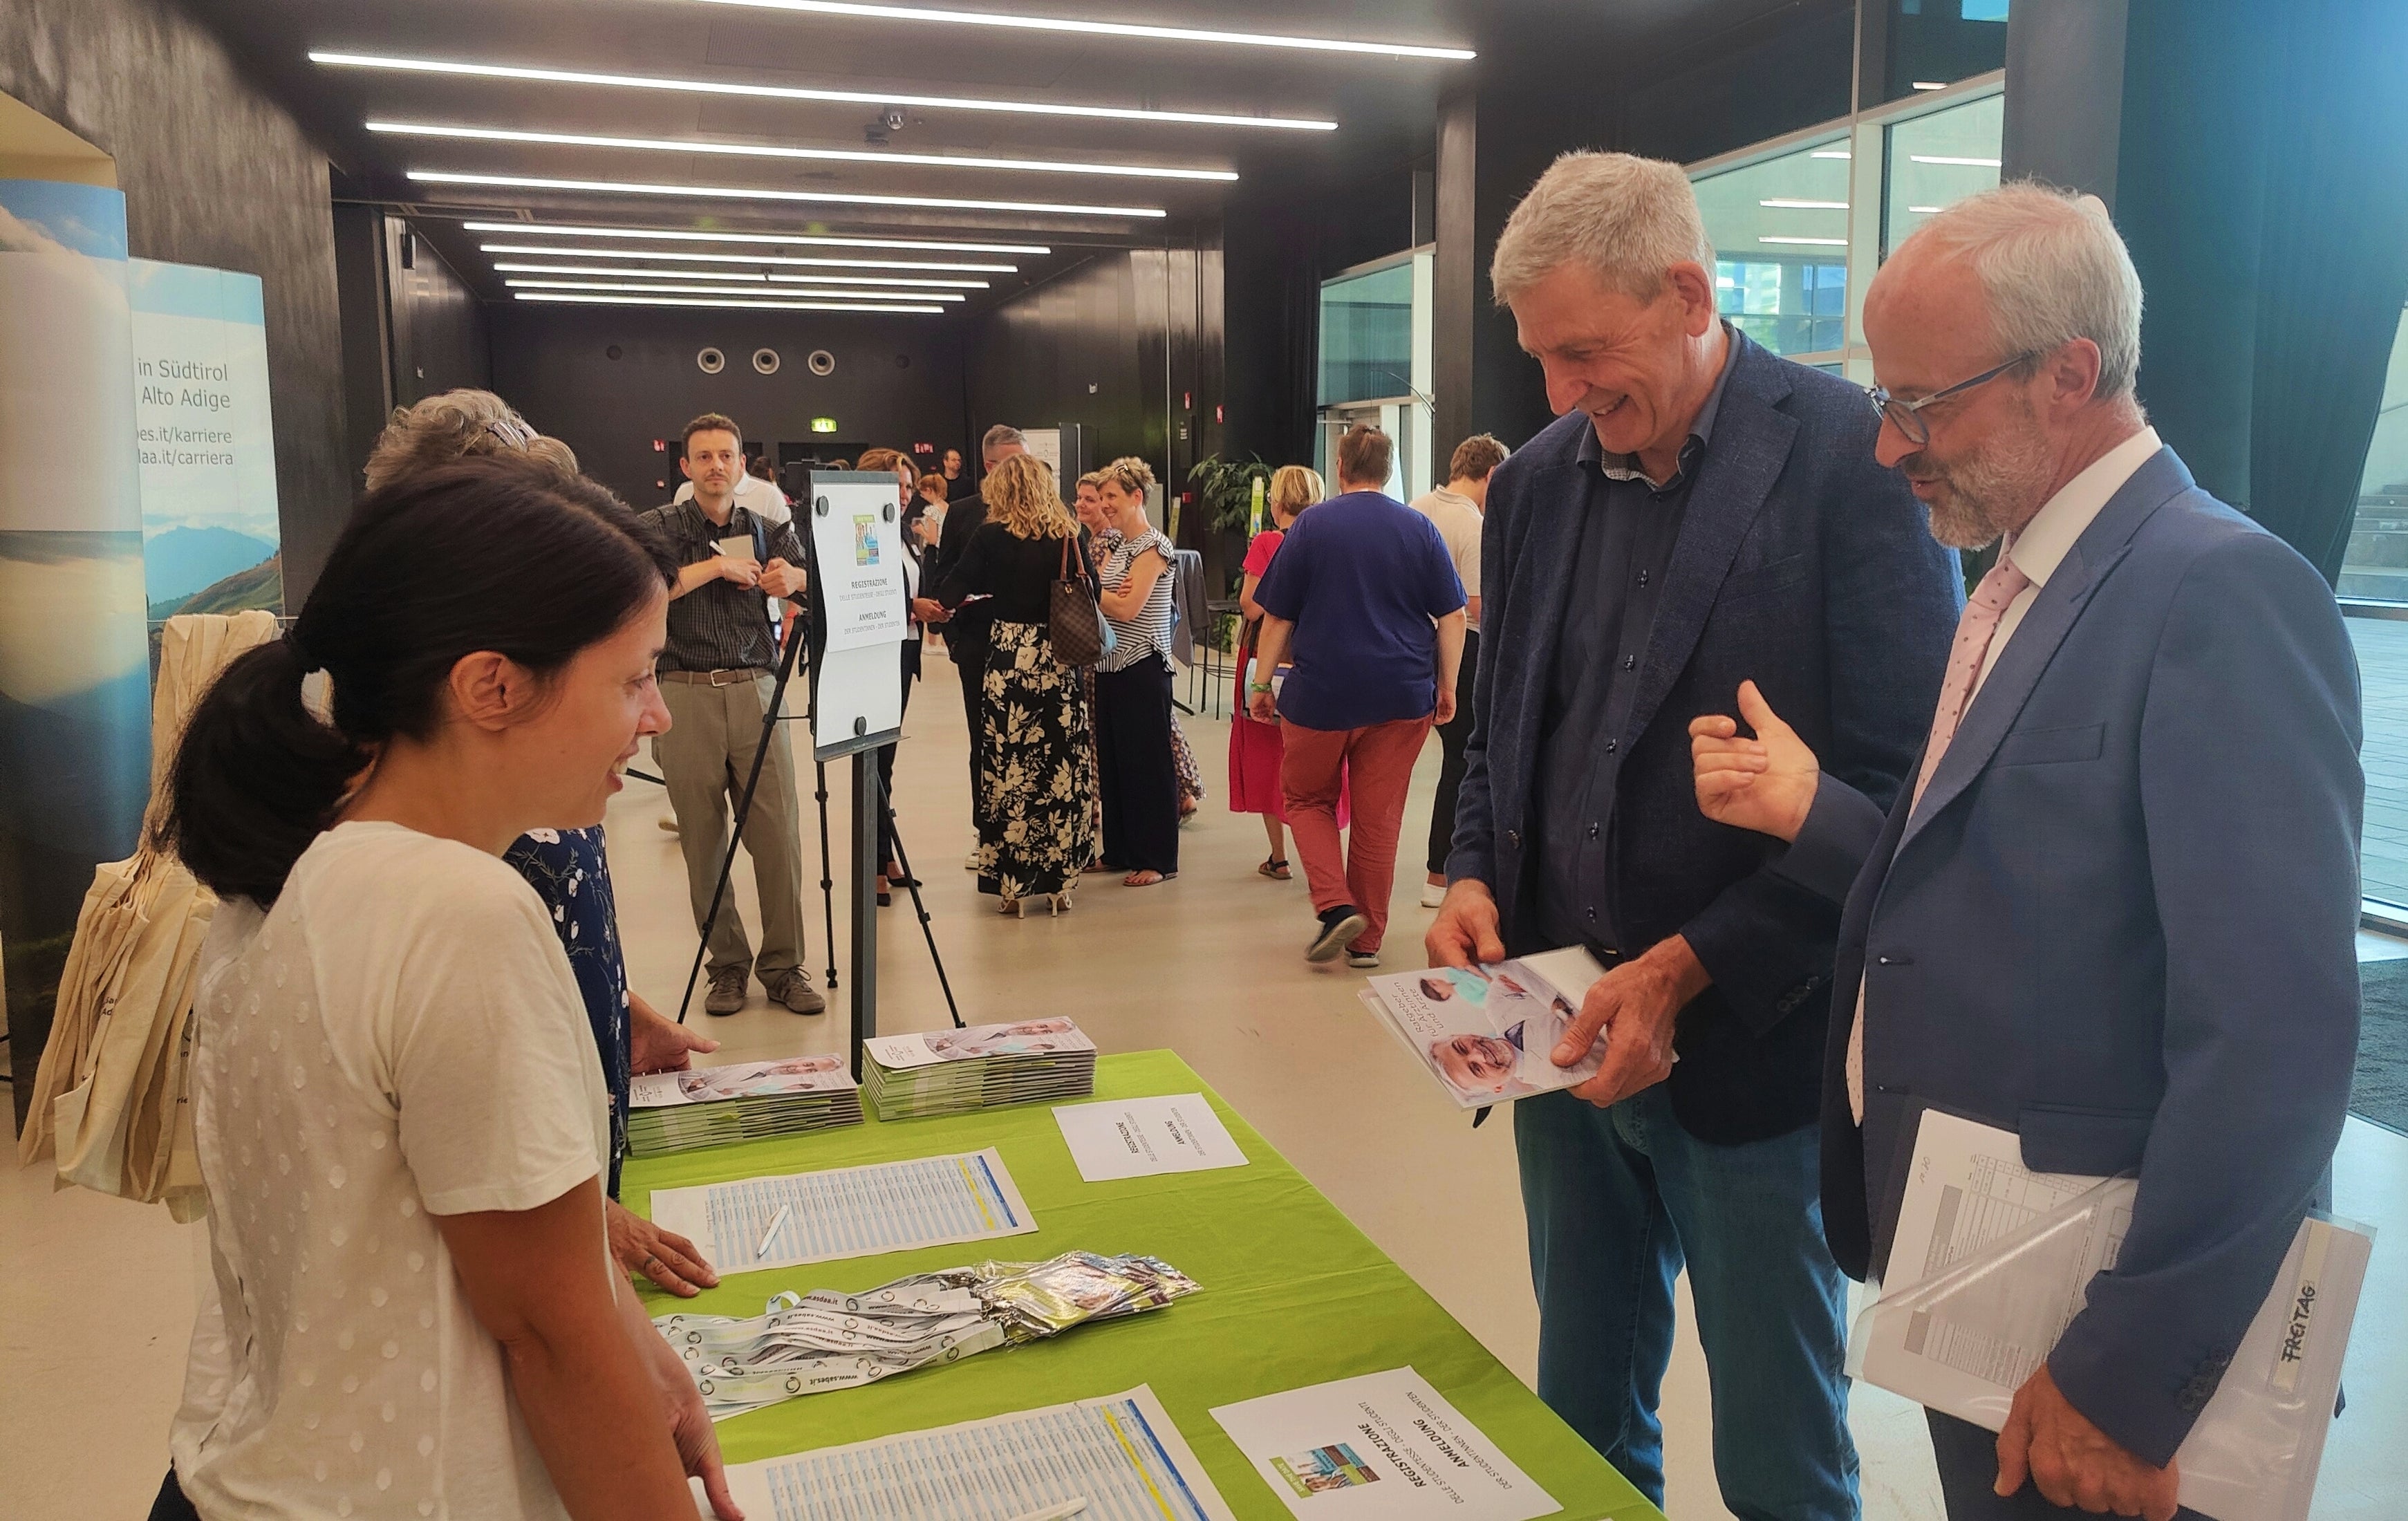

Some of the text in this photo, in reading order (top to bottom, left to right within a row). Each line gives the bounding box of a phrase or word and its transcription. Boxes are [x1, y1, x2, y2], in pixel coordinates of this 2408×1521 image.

[138, 357, 228, 382] in Südtirol
[142, 386, 231, 412] Alto Adige
[851, 578, 888, 590] REGISTRAZIONE
[1391, 993, 1424, 1033] Ratgeber
[1426, 1012, 1444, 1029] und
[805, 1295, 839, 1305] w.asdaa.it
[810, 1374, 858, 1386] www.sabes.it
[1358, 1401, 1388, 1428] STUDENTI
[1405, 1390, 1440, 1421] STUDENTEN
[1384, 1426, 1404, 1444] DEGLI
[1436, 1419, 1452, 1433] DER
[1357, 1422, 1427, 1489] REGISTRAZIONE
[1412, 1418, 1471, 1469] ANMELDUNG
[1403, 1447, 1446, 1486] STUDENTESSE
[1453, 1435, 1500, 1478] STUDENTINNEN
[1441, 1485, 1465, 1505] DELLE
[1495, 1476, 1513, 1491] DER
